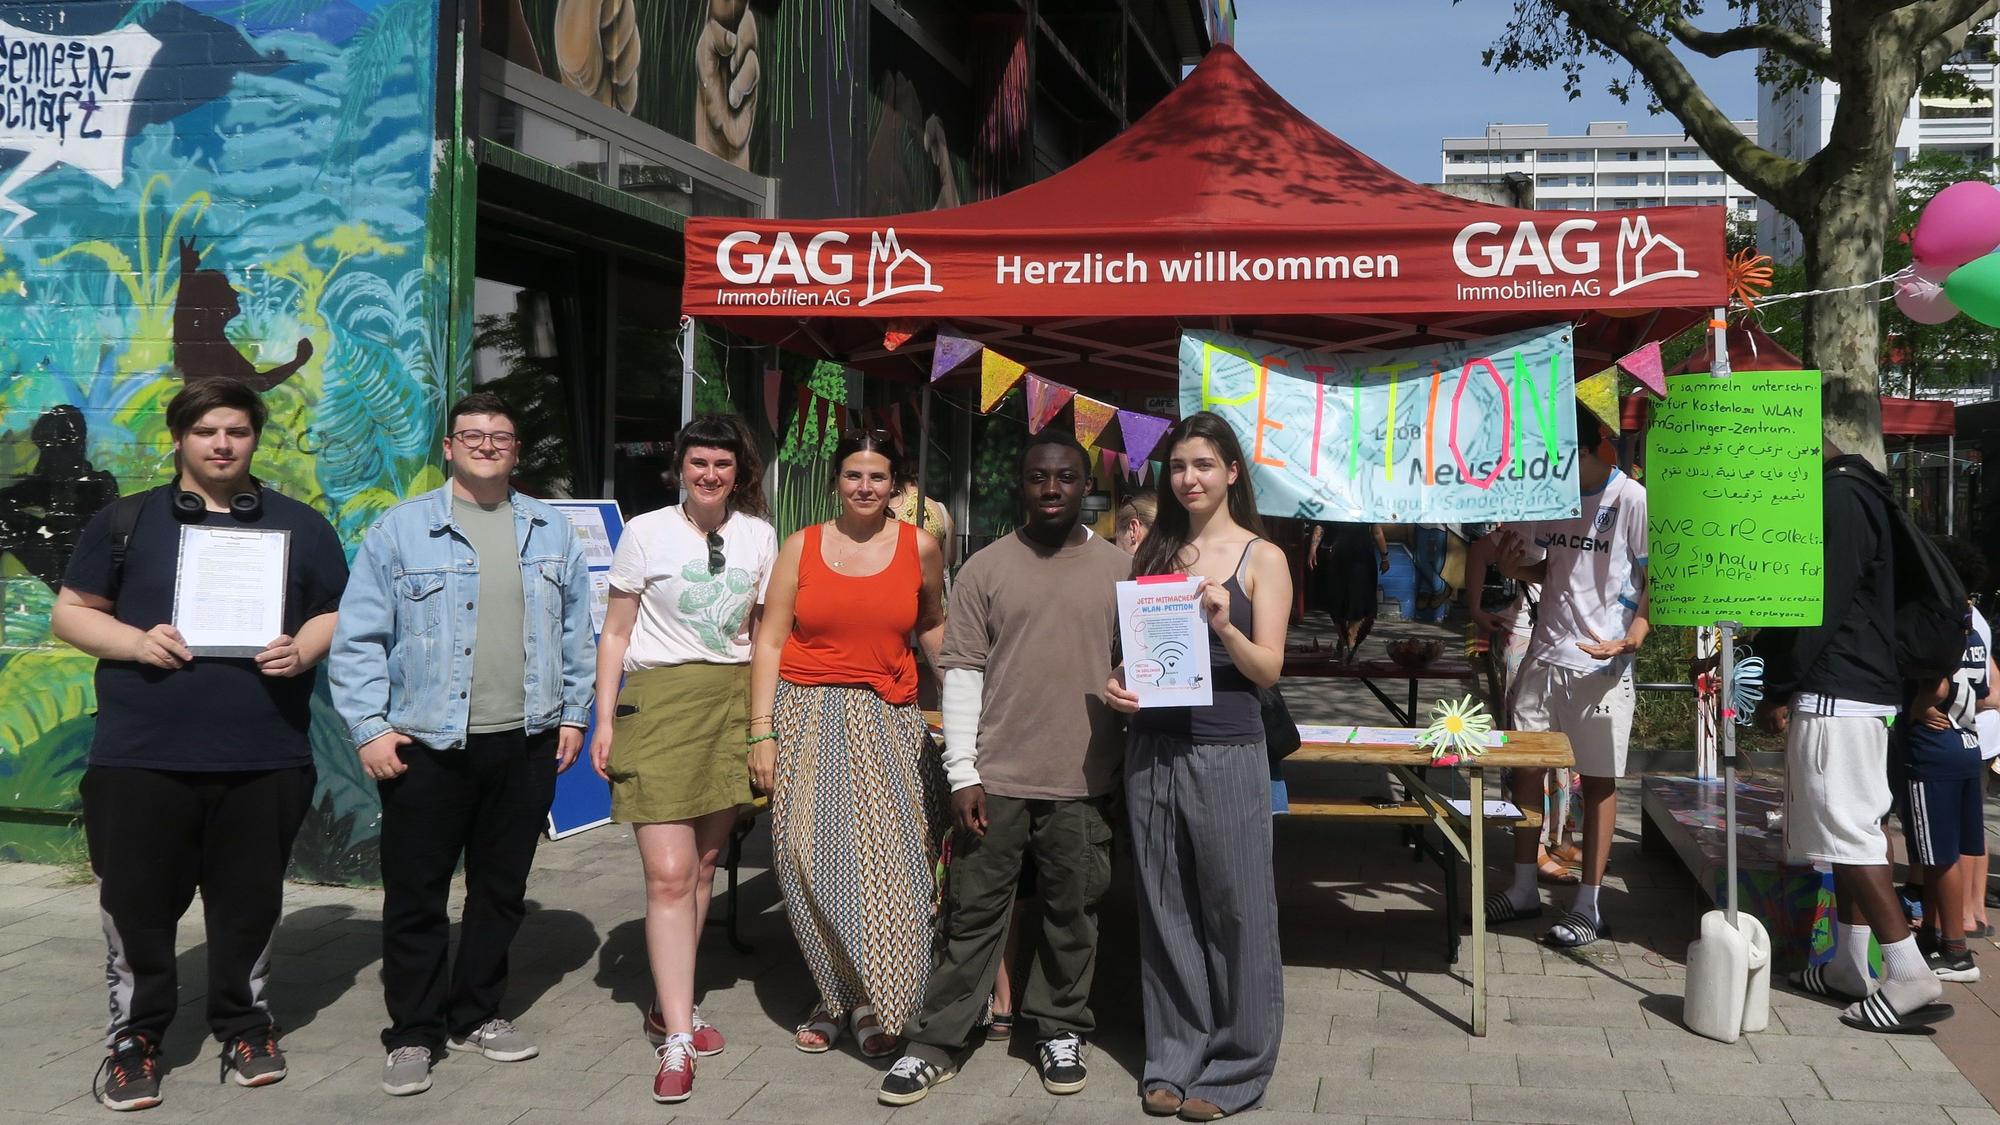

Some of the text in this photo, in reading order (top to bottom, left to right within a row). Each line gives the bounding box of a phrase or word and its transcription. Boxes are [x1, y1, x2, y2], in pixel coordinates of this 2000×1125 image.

[1452, 218, 1600, 277] GAG
[716, 231, 853, 285] GAG
[996, 251, 1399, 284] Herzlich willkommen
[716, 288, 851, 306] Immobilien AG
[1457, 279, 1600, 301] Immobilien AG
[1681, 380, 1741, 392] sammeln
[1201, 340, 1560, 489] PETITION
[1762, 404, 1803, 417] WLAN
[1656, 442, 1688, 455] خدمة
[1693, 442, 1723, 456] توفير
[1726, 443, 1745, 459] في
[1787, 466, 1808, 482] واي
[1701, 518, 1756, 541] are
[1570, 535, 1609, 553] CGM
[1800, 562, 1822, 576] for
